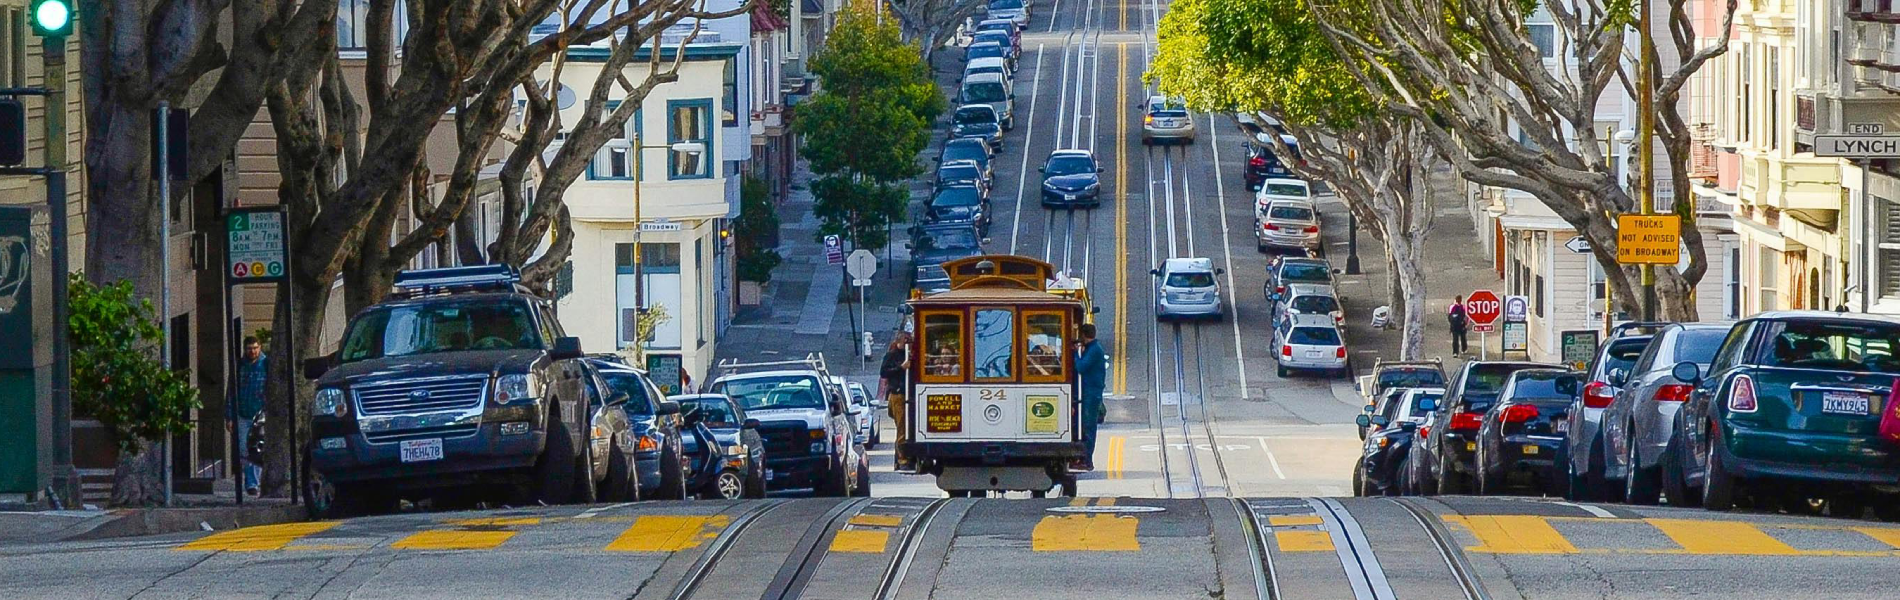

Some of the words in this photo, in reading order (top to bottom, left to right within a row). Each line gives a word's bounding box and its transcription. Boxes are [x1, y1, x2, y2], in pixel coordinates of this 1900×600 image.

[1855, 125, 1880, 133] END
[1834, 140, 1896, 153] LYNCH
[234, 215, 243, 229] 2
[1634, 220, 1664, 229] TRUCKS
[643, 223, 679, 231] Broadway
[1621, 234, 1637, 242] NOT
[1642, 234, 1675, 243] ADVISED
[1620, 248, 1630, 256] ON
[1635, 248, 1677, 256] BROADWAY
[236, 264, 246, 275] A
[253, 264, 262, 275] C
[270, 263, 279, 274] G
[1468, 300, 1499, 314] STOP
[1566, 335, 1574, 344] 2
[980, 389, 1007, 400] 24
[1825, 398, 1867, 413] 7KMY945
[1139, 443, 1251, 452] STOP
